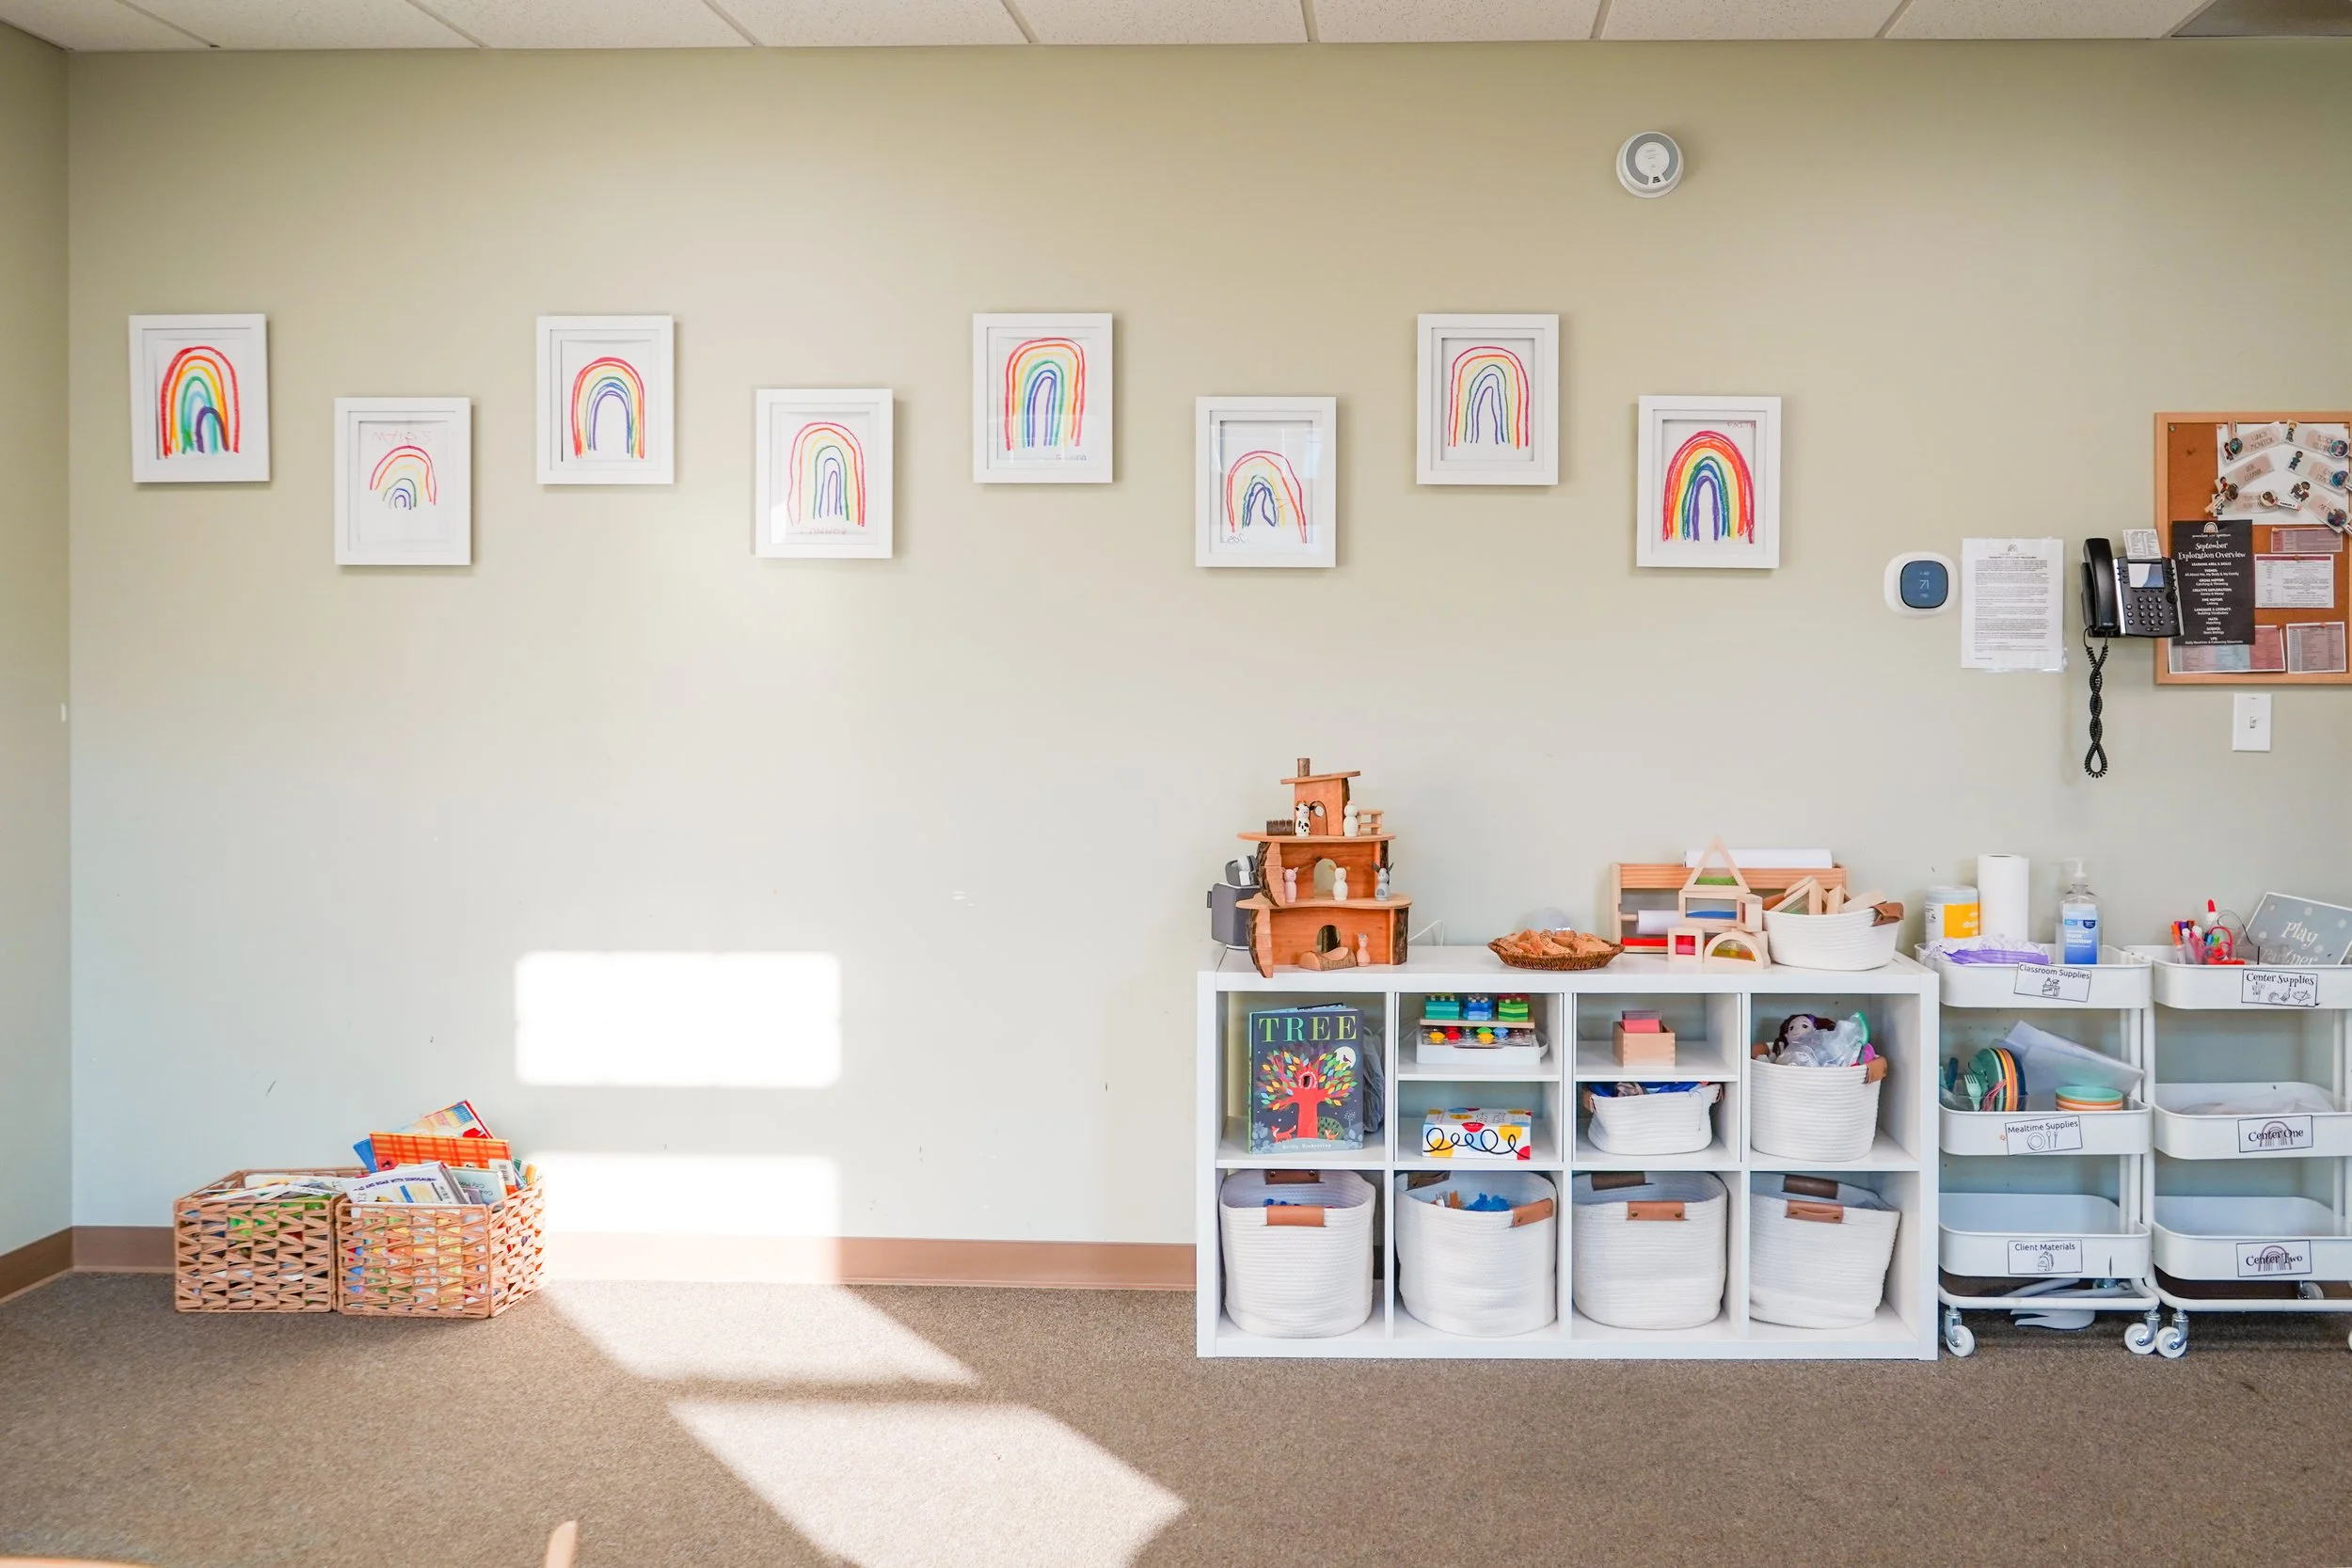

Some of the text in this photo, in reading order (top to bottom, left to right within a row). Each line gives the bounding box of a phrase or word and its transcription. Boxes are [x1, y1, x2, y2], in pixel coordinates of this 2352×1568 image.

[2195, 540, 2228, 552] September
[2178, 551, 2214, 562] Exploration
[1919, 579, 1929, 590] 71
[2280, 921, 2319, 950] Play
[2019, 964, 2090, 980] Classroom Supplies
[2246, 973, 2314, 988] Center Supplies
[1258, 1015, 1358, 1042] TREE
[2008, 1120, 2078, 1133] Mealtime Supplies
[2248, 1129, 2304, 1143] Center One
[2014, 1242, 2076, 1251] Client Materials
[2245, 1252, 2303, 1266] Center Two
